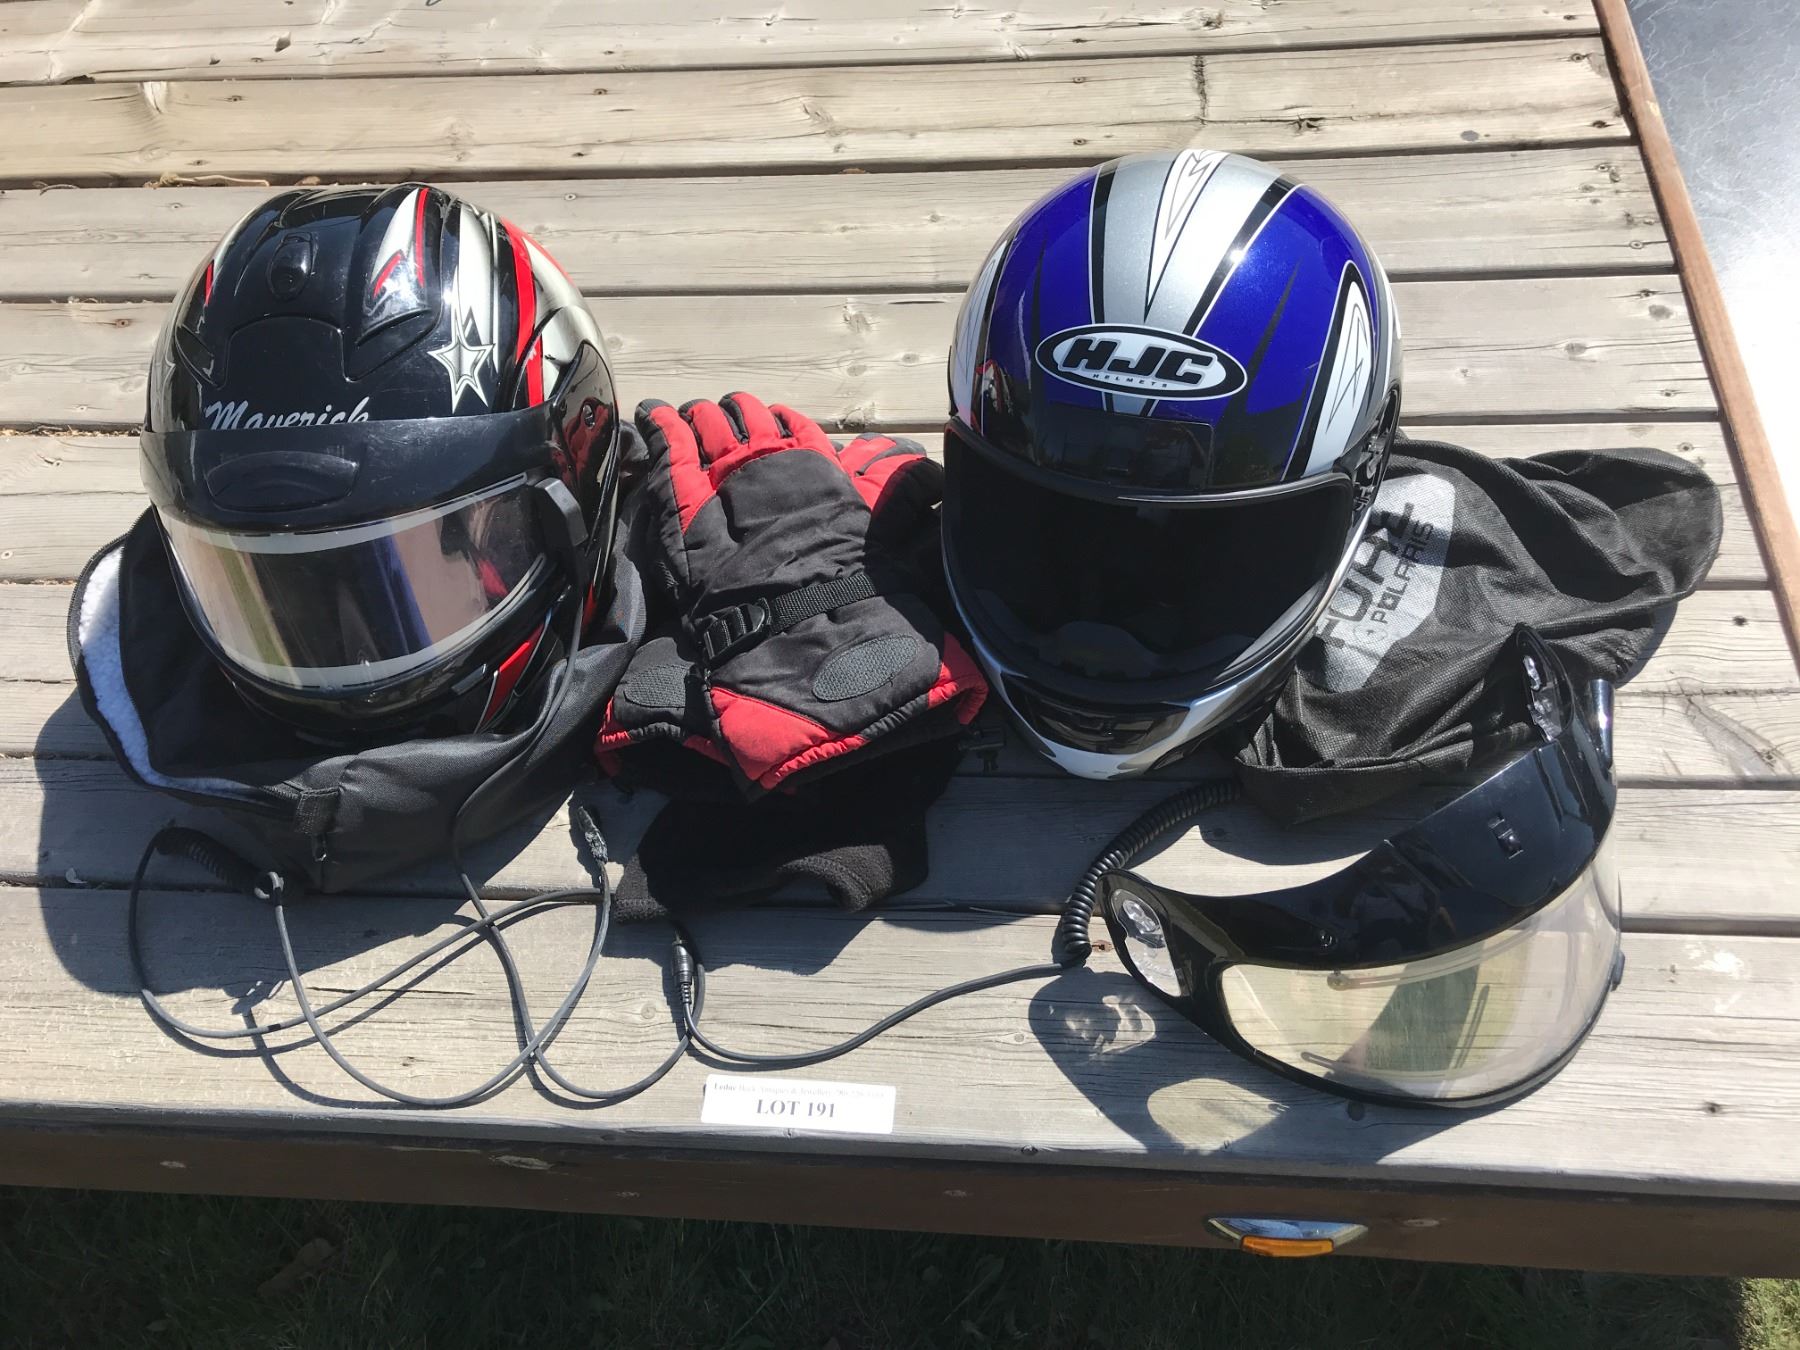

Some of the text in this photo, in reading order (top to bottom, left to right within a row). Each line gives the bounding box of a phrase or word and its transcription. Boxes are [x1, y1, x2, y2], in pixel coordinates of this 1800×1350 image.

[1061, 337, 1214, 385] HJC
[1092, 373, 1168, 388] HELMETS
[1370, 522, 1434, 624] POLARIS
[756, 1099, 835, 1118] LOT 191
